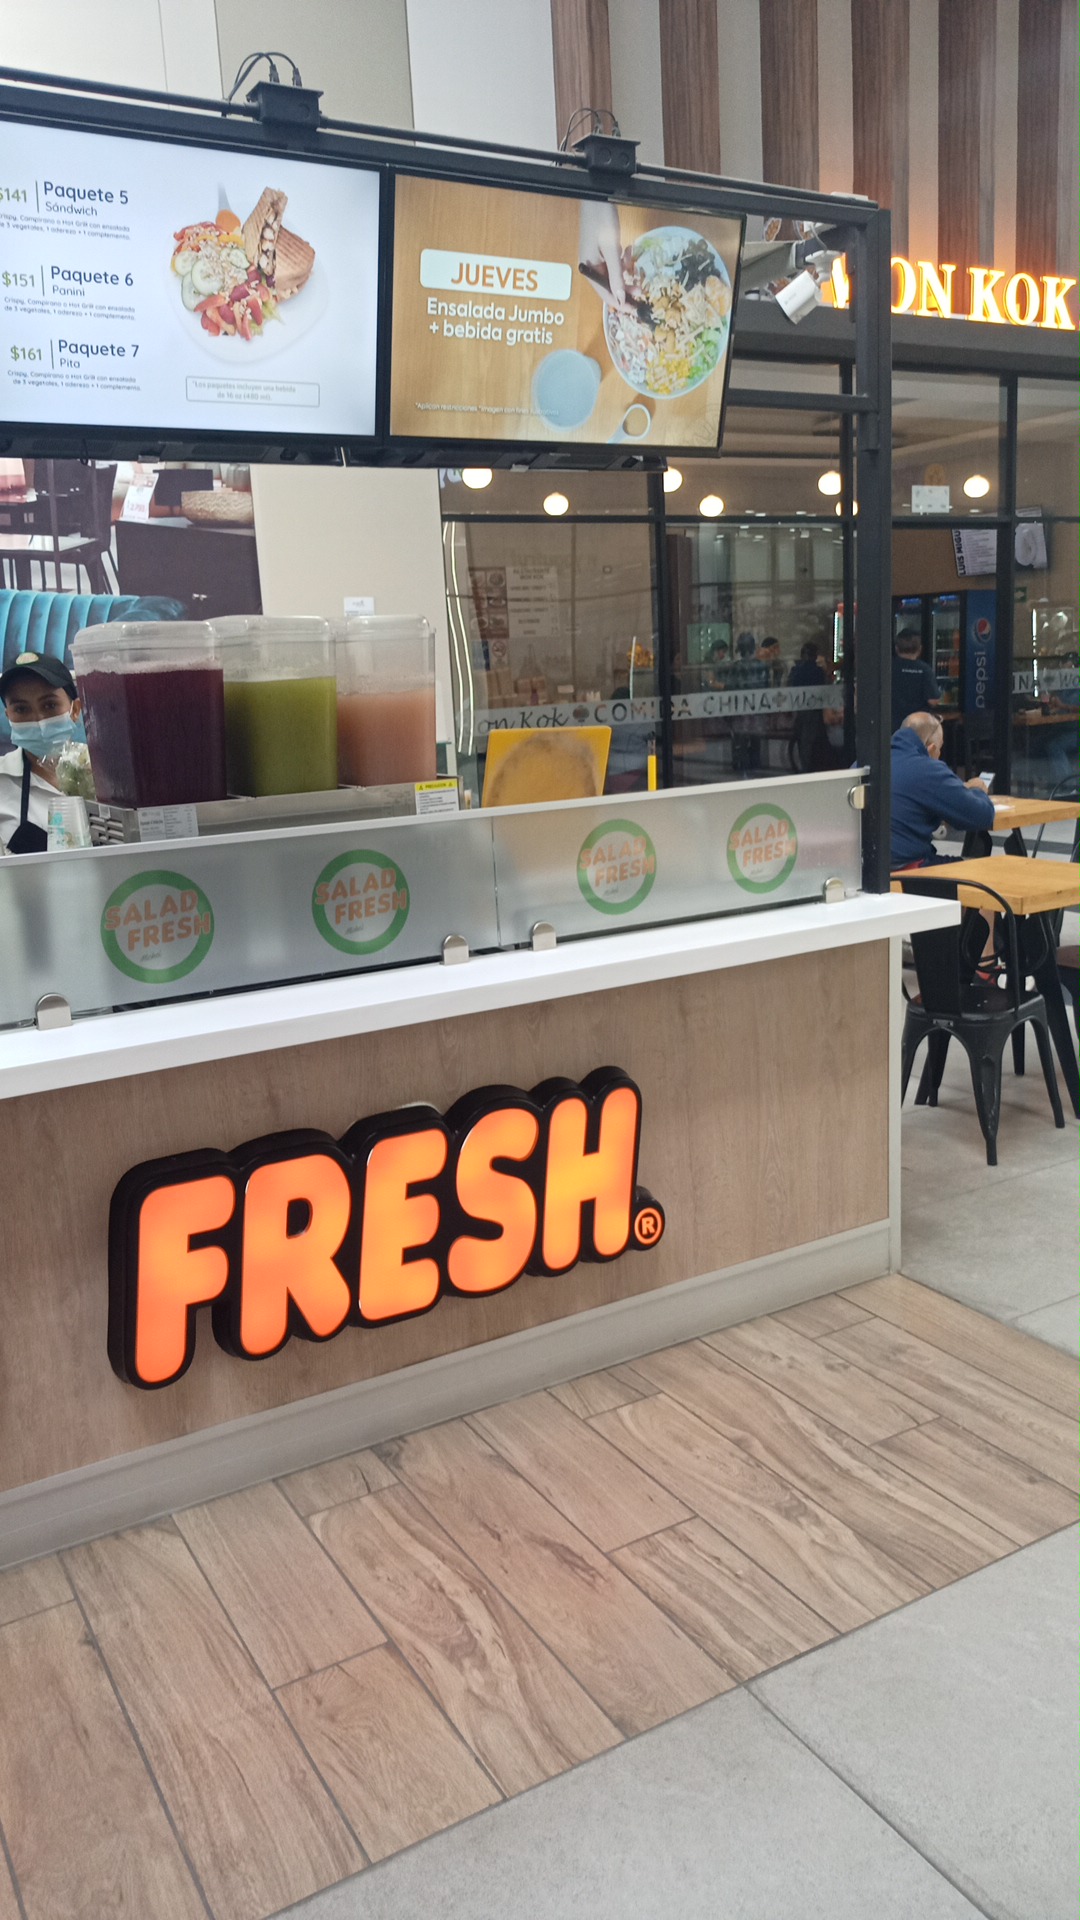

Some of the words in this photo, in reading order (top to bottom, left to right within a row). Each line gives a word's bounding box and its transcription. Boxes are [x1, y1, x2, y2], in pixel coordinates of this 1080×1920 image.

[44, 181, 114, 203] Paquete
[120, 190, 129, 205] 5
[45, 201, 98, 216] Sándwich
[2, 270, 35, 288] $151
[51, 265, 119, 285] Paquete
[125, 272, 134, 287] 6
[451, 262, 538, 292] JUEVES
[52, 285, 85, 297] Panini
[966, 266, 1077, 331] KOK
[427, 297, 505, 320] Ensalada
[508, 305, 564, 325] Jumbo
[430, 322, 439, 334] +
[444, 320, 502, 341] bebida
[506, 326, 553, 346] gratis
[10, 344, 42, 362] $161
[58, 339, 126, 358] Paquete
[131, 344, 139, 358] 7
[60, 358, 80, 368] Pita
[954, 530, 963, 554] MIGU
[957, 556, 966, 575] LUIS
[975, 652, 988, 708] pepsi
[1012, 674, 1041, 691] INA
[1060, 672, 1080, 688] Wo
[478, 717, 515, 735] on
[520, 706, 569, 729] Kok
[703, 692, 771, 715] CHINA
[730, 819, 789, 850] SALAD
[580, 836, 647, 870] SALAD
[742, 838, 796, 867] FRESH
[594, 856, 655, 887] FRESH
[315, 868, 397, 905] SALAD
[104, 890, 199, 932] SALAD
[335, 887, 407, 925] FRESH
[127, 911, 211, 952] FRESH
[134, 1086, 637, 1384] FRESH
